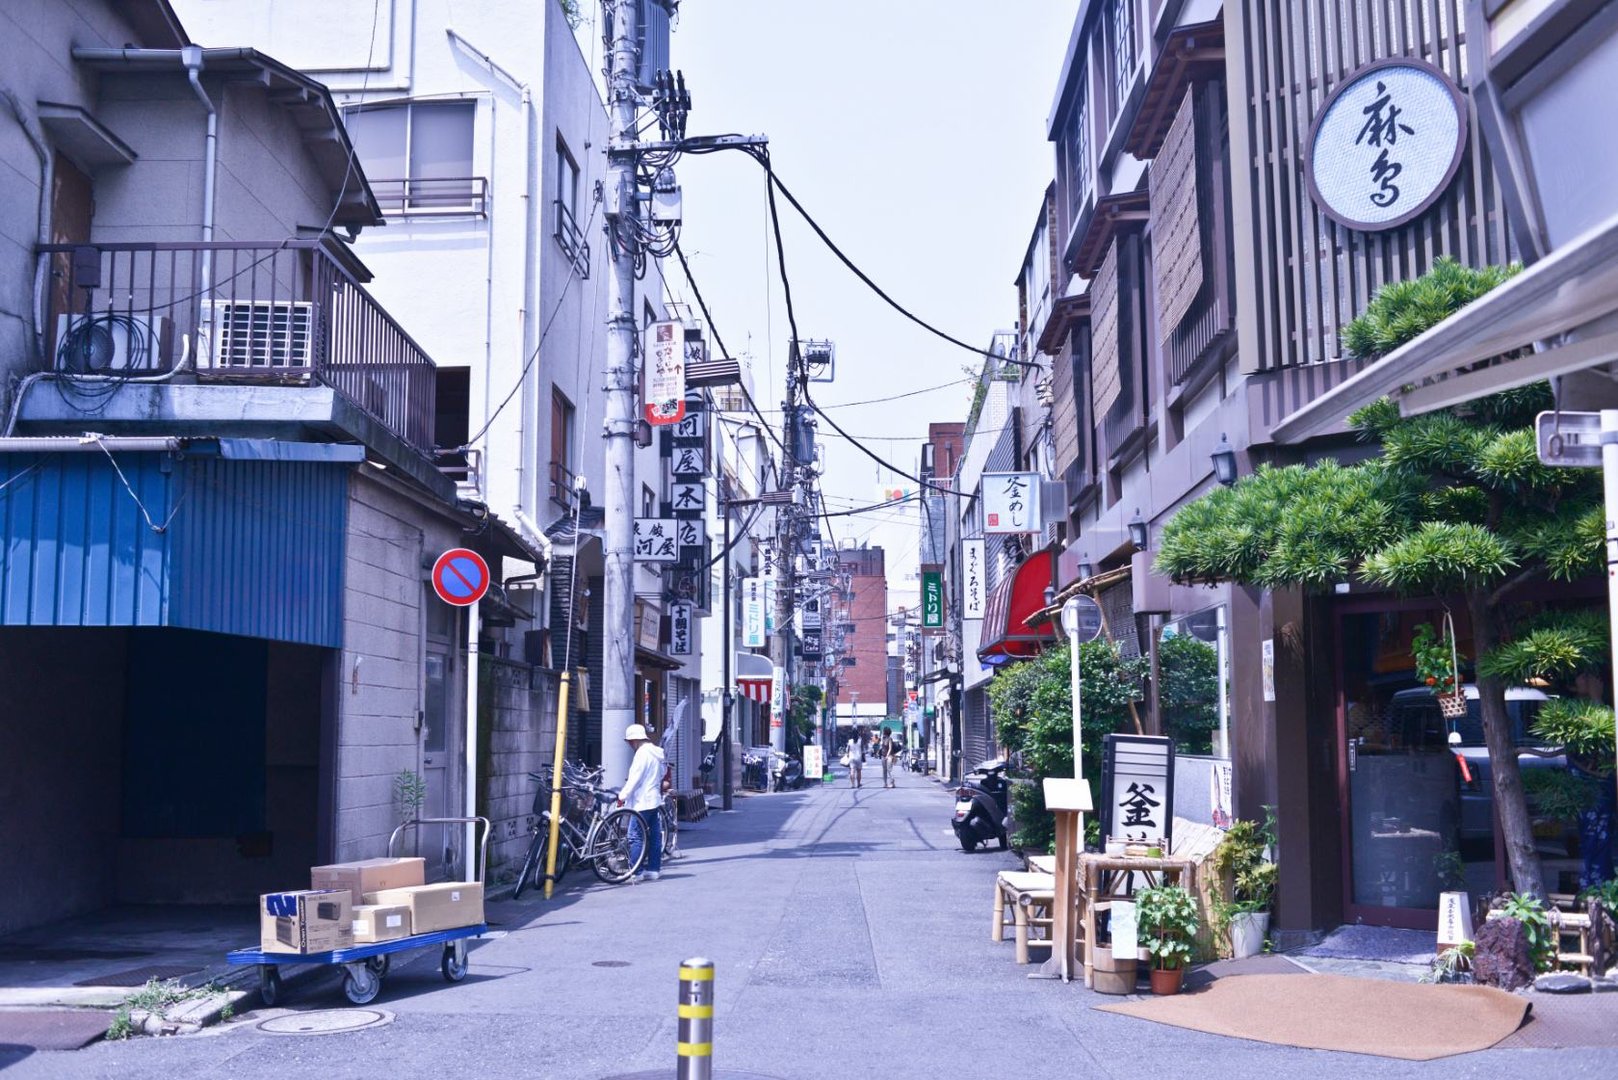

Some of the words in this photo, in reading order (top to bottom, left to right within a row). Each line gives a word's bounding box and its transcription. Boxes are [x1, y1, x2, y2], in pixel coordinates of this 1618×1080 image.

[1003, 475, 1028, 527] 釜めし
[969, 547, 980, 612] まぐろそば
